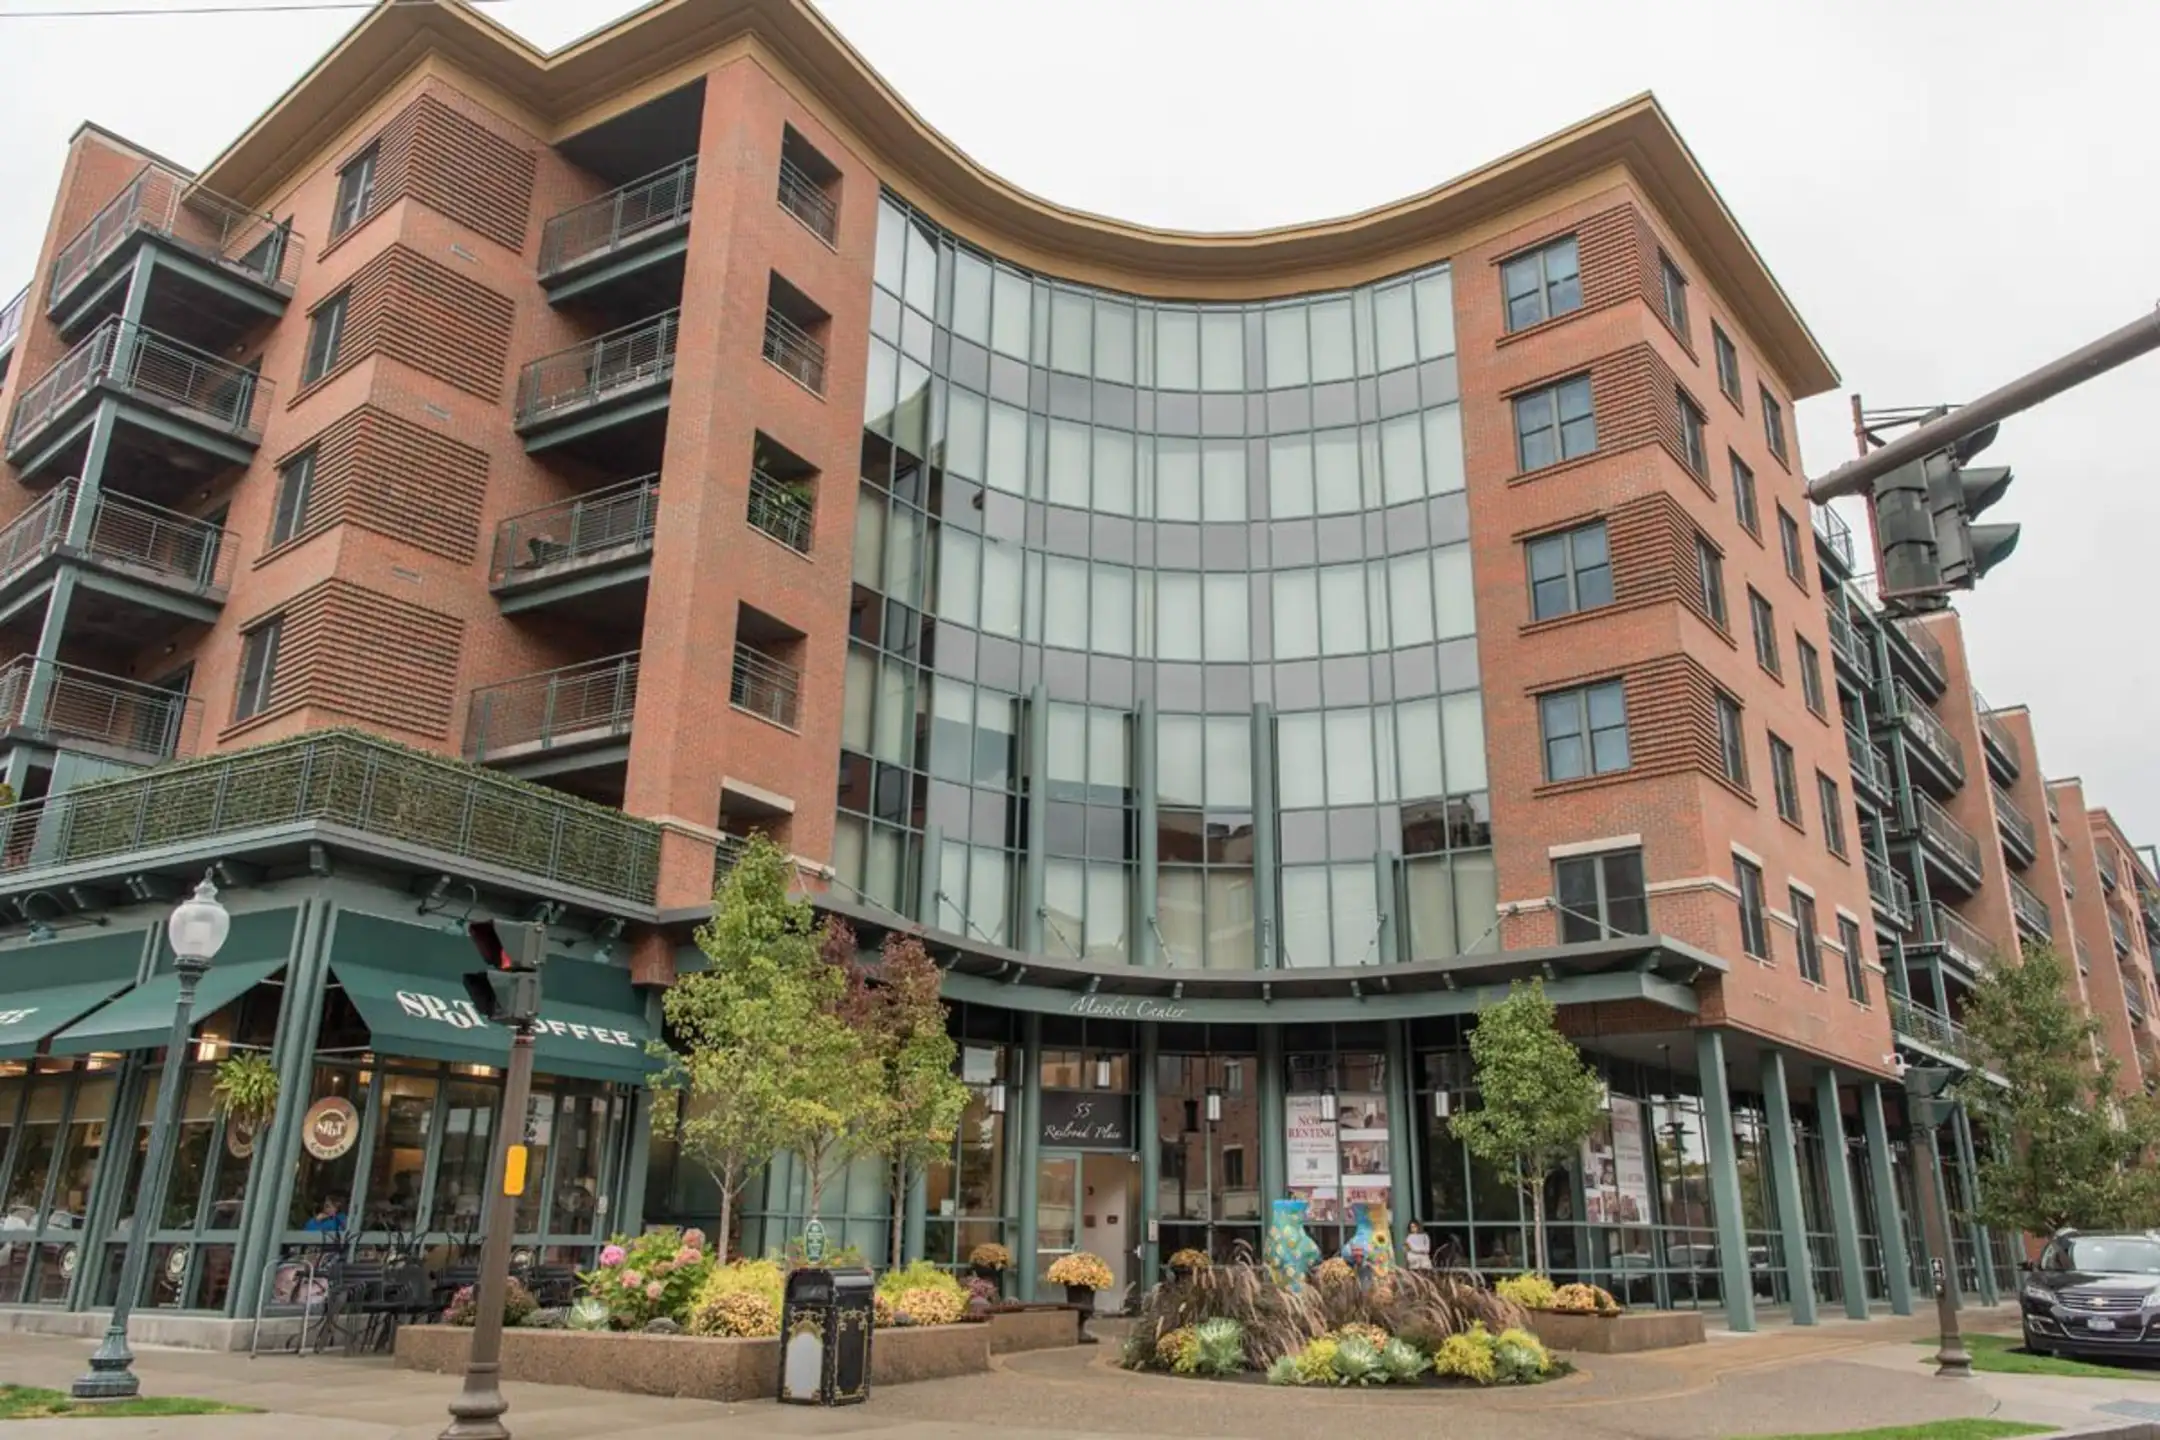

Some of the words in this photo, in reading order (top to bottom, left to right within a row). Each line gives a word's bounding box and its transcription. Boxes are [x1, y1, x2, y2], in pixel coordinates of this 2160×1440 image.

[1070, 996, 1130, 1018] Market
[1137, 1000, 1189, 1019] Center
[507, 1017, 638, 1049] OFFEE
[1073, 1101, 1094, 1119] 55
[1288, 1128, 1335, 1139] RENTING
